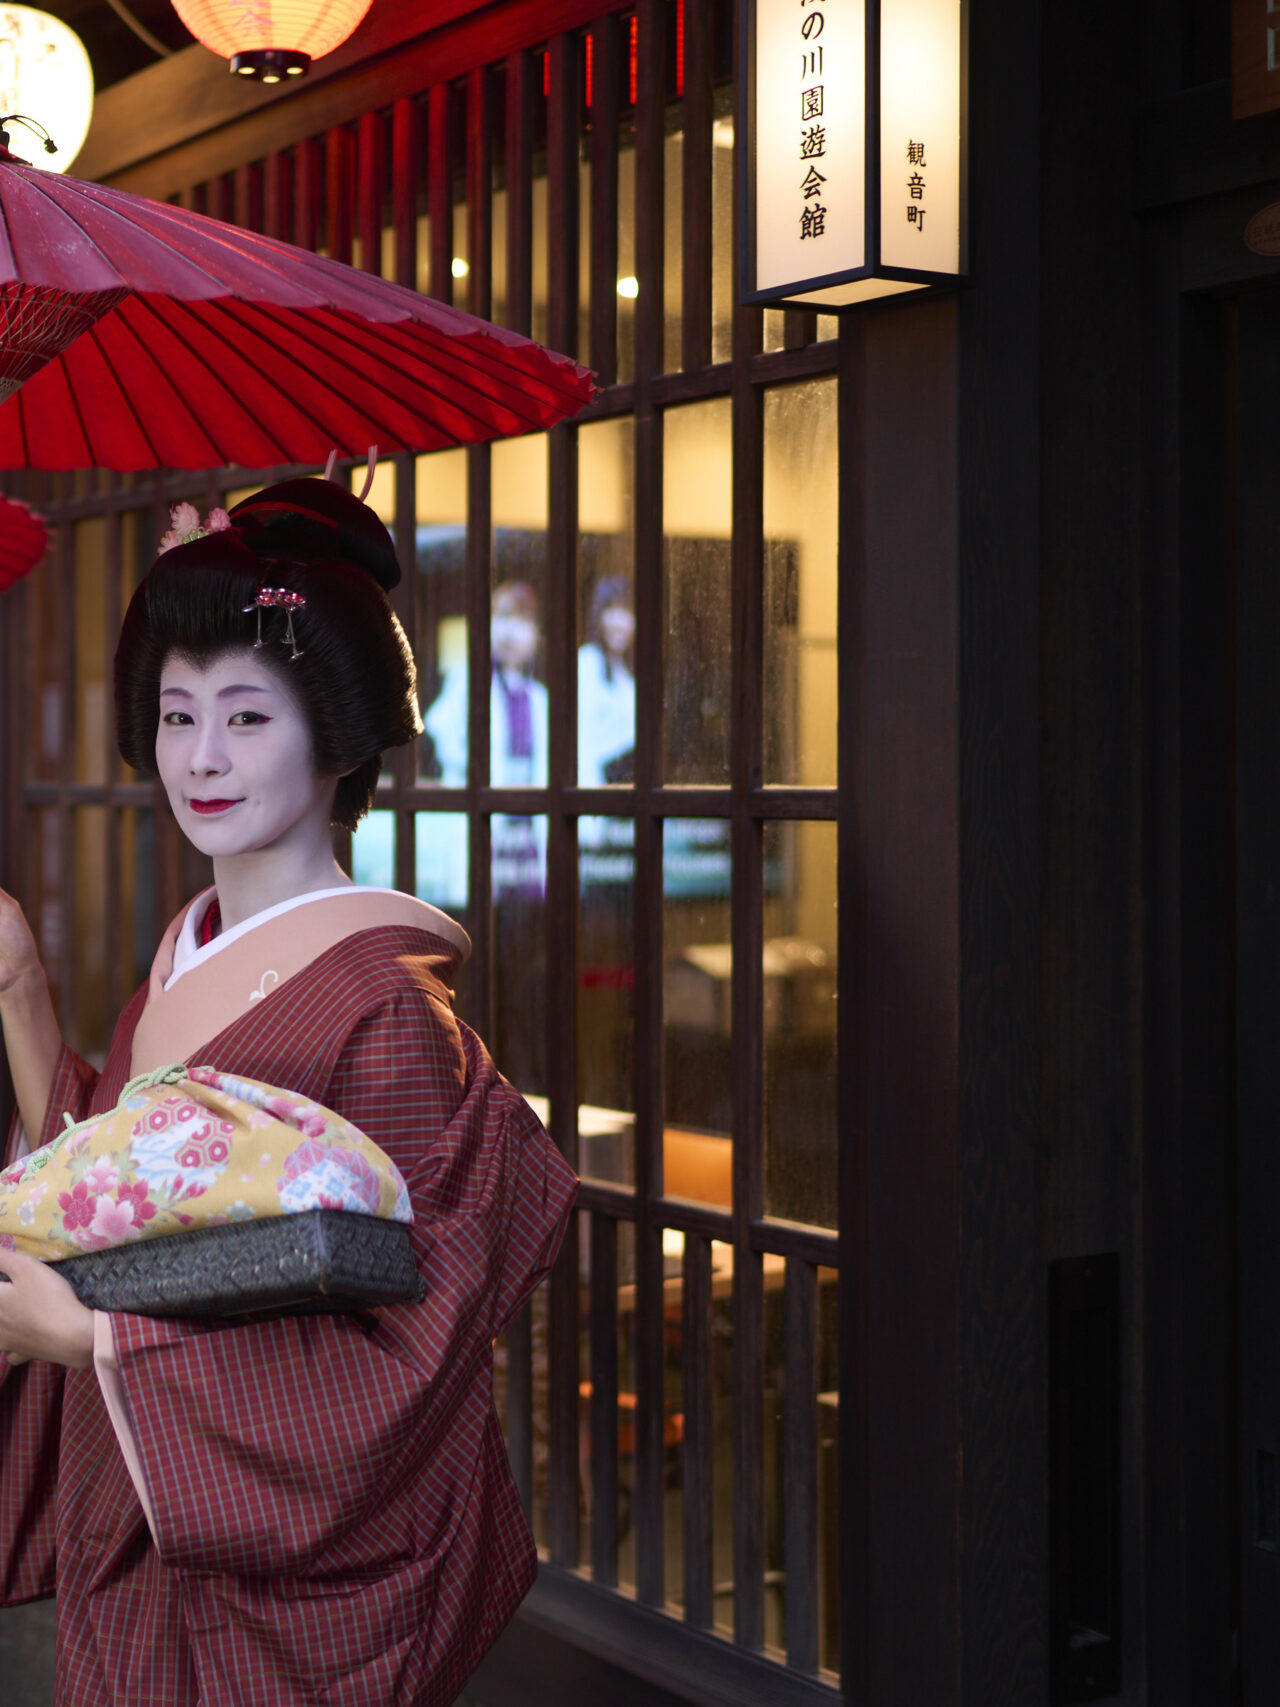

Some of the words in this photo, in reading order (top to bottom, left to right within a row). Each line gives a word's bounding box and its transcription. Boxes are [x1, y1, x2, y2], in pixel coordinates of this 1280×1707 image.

[799, 0, 827, 240] の川園遊会館
[906, 139, 927, 232] 観音町
